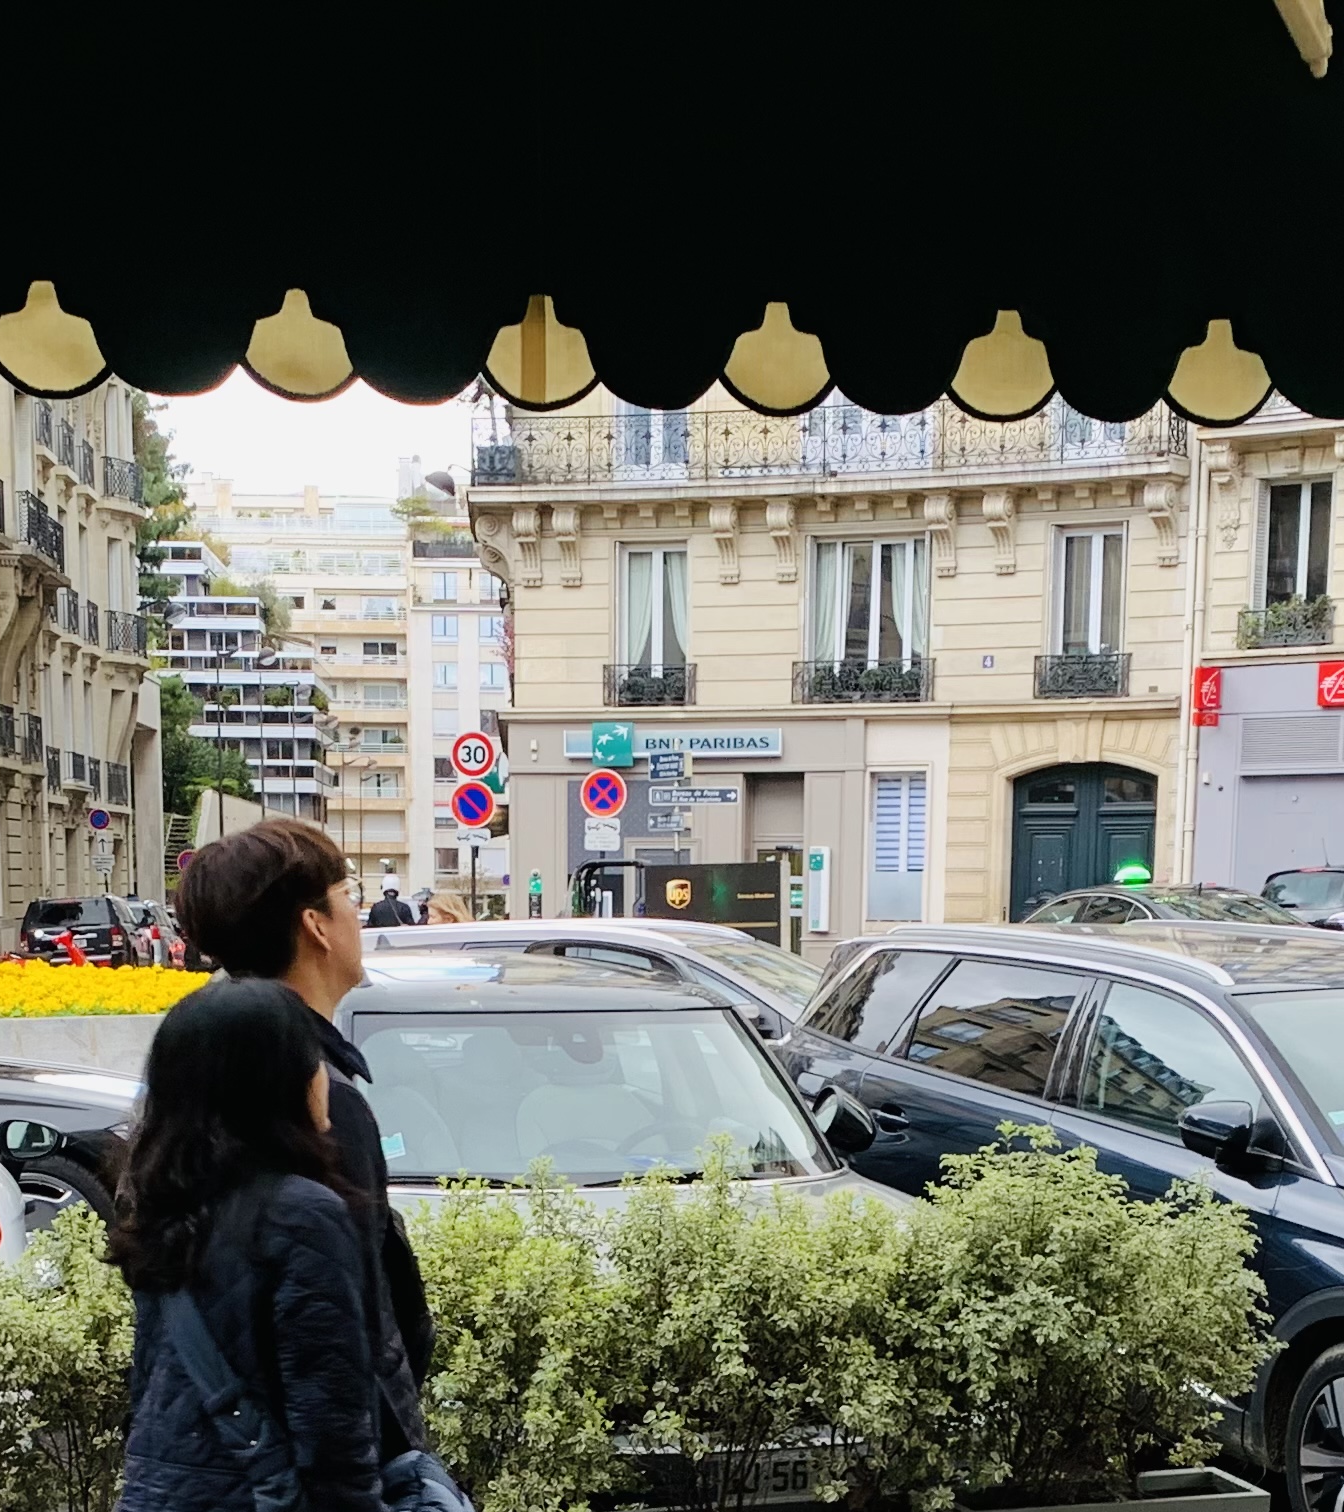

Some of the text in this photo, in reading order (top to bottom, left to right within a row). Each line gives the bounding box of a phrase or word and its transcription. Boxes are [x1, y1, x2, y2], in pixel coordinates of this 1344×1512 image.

[984, 656, 992, 667] 4
[689, 736, 770, 749] PARIBAS
[461, 745, 486, 764] 30
[669, 889, 689, 905] ups
